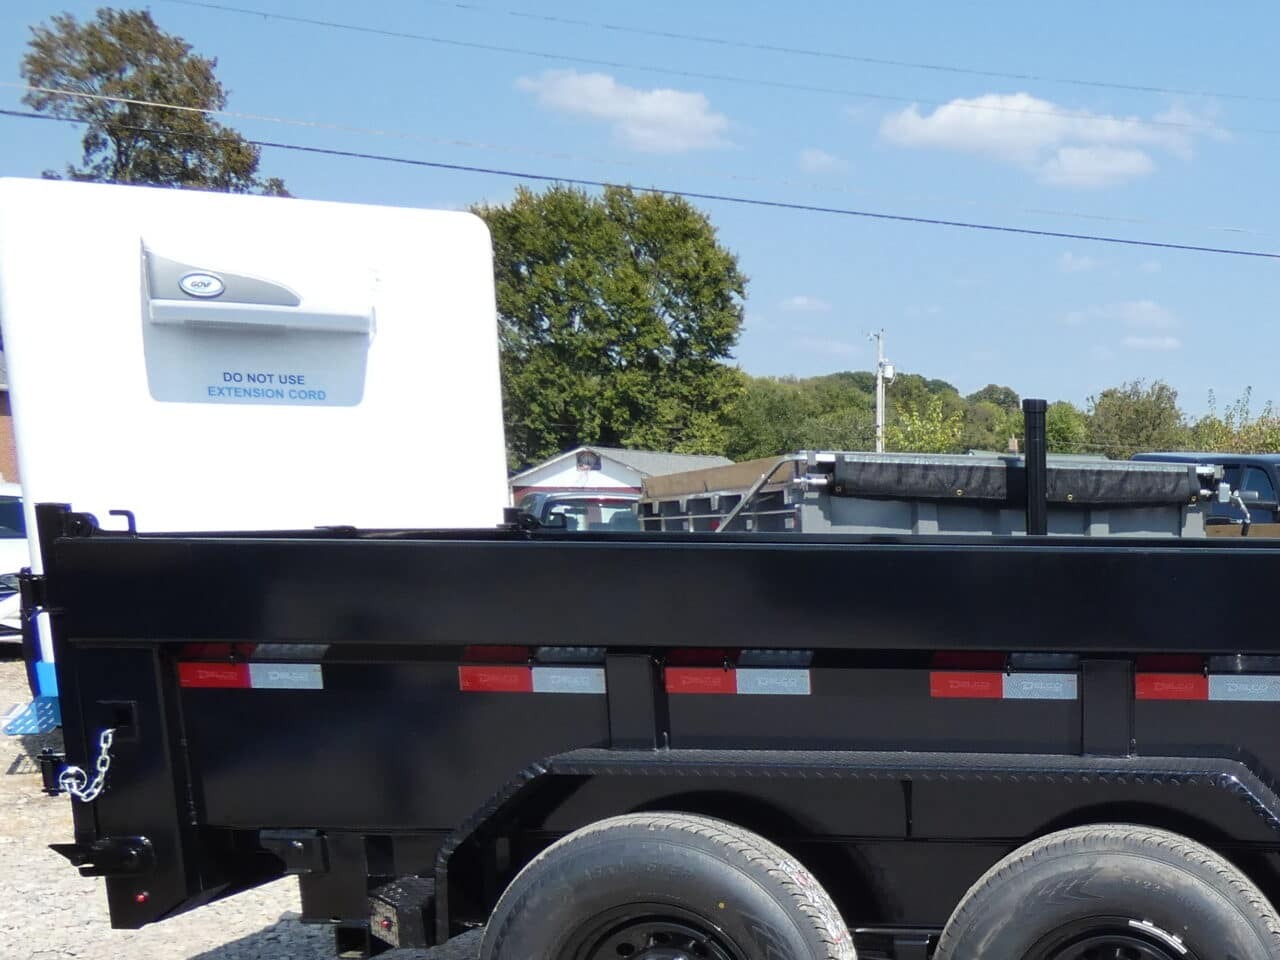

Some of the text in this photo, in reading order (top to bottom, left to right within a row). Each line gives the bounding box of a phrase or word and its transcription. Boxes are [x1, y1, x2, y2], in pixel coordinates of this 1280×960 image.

[223, 372, 305, 385] DO NOT USE
[207, 386, 327, 401] EXTENSION CORD
